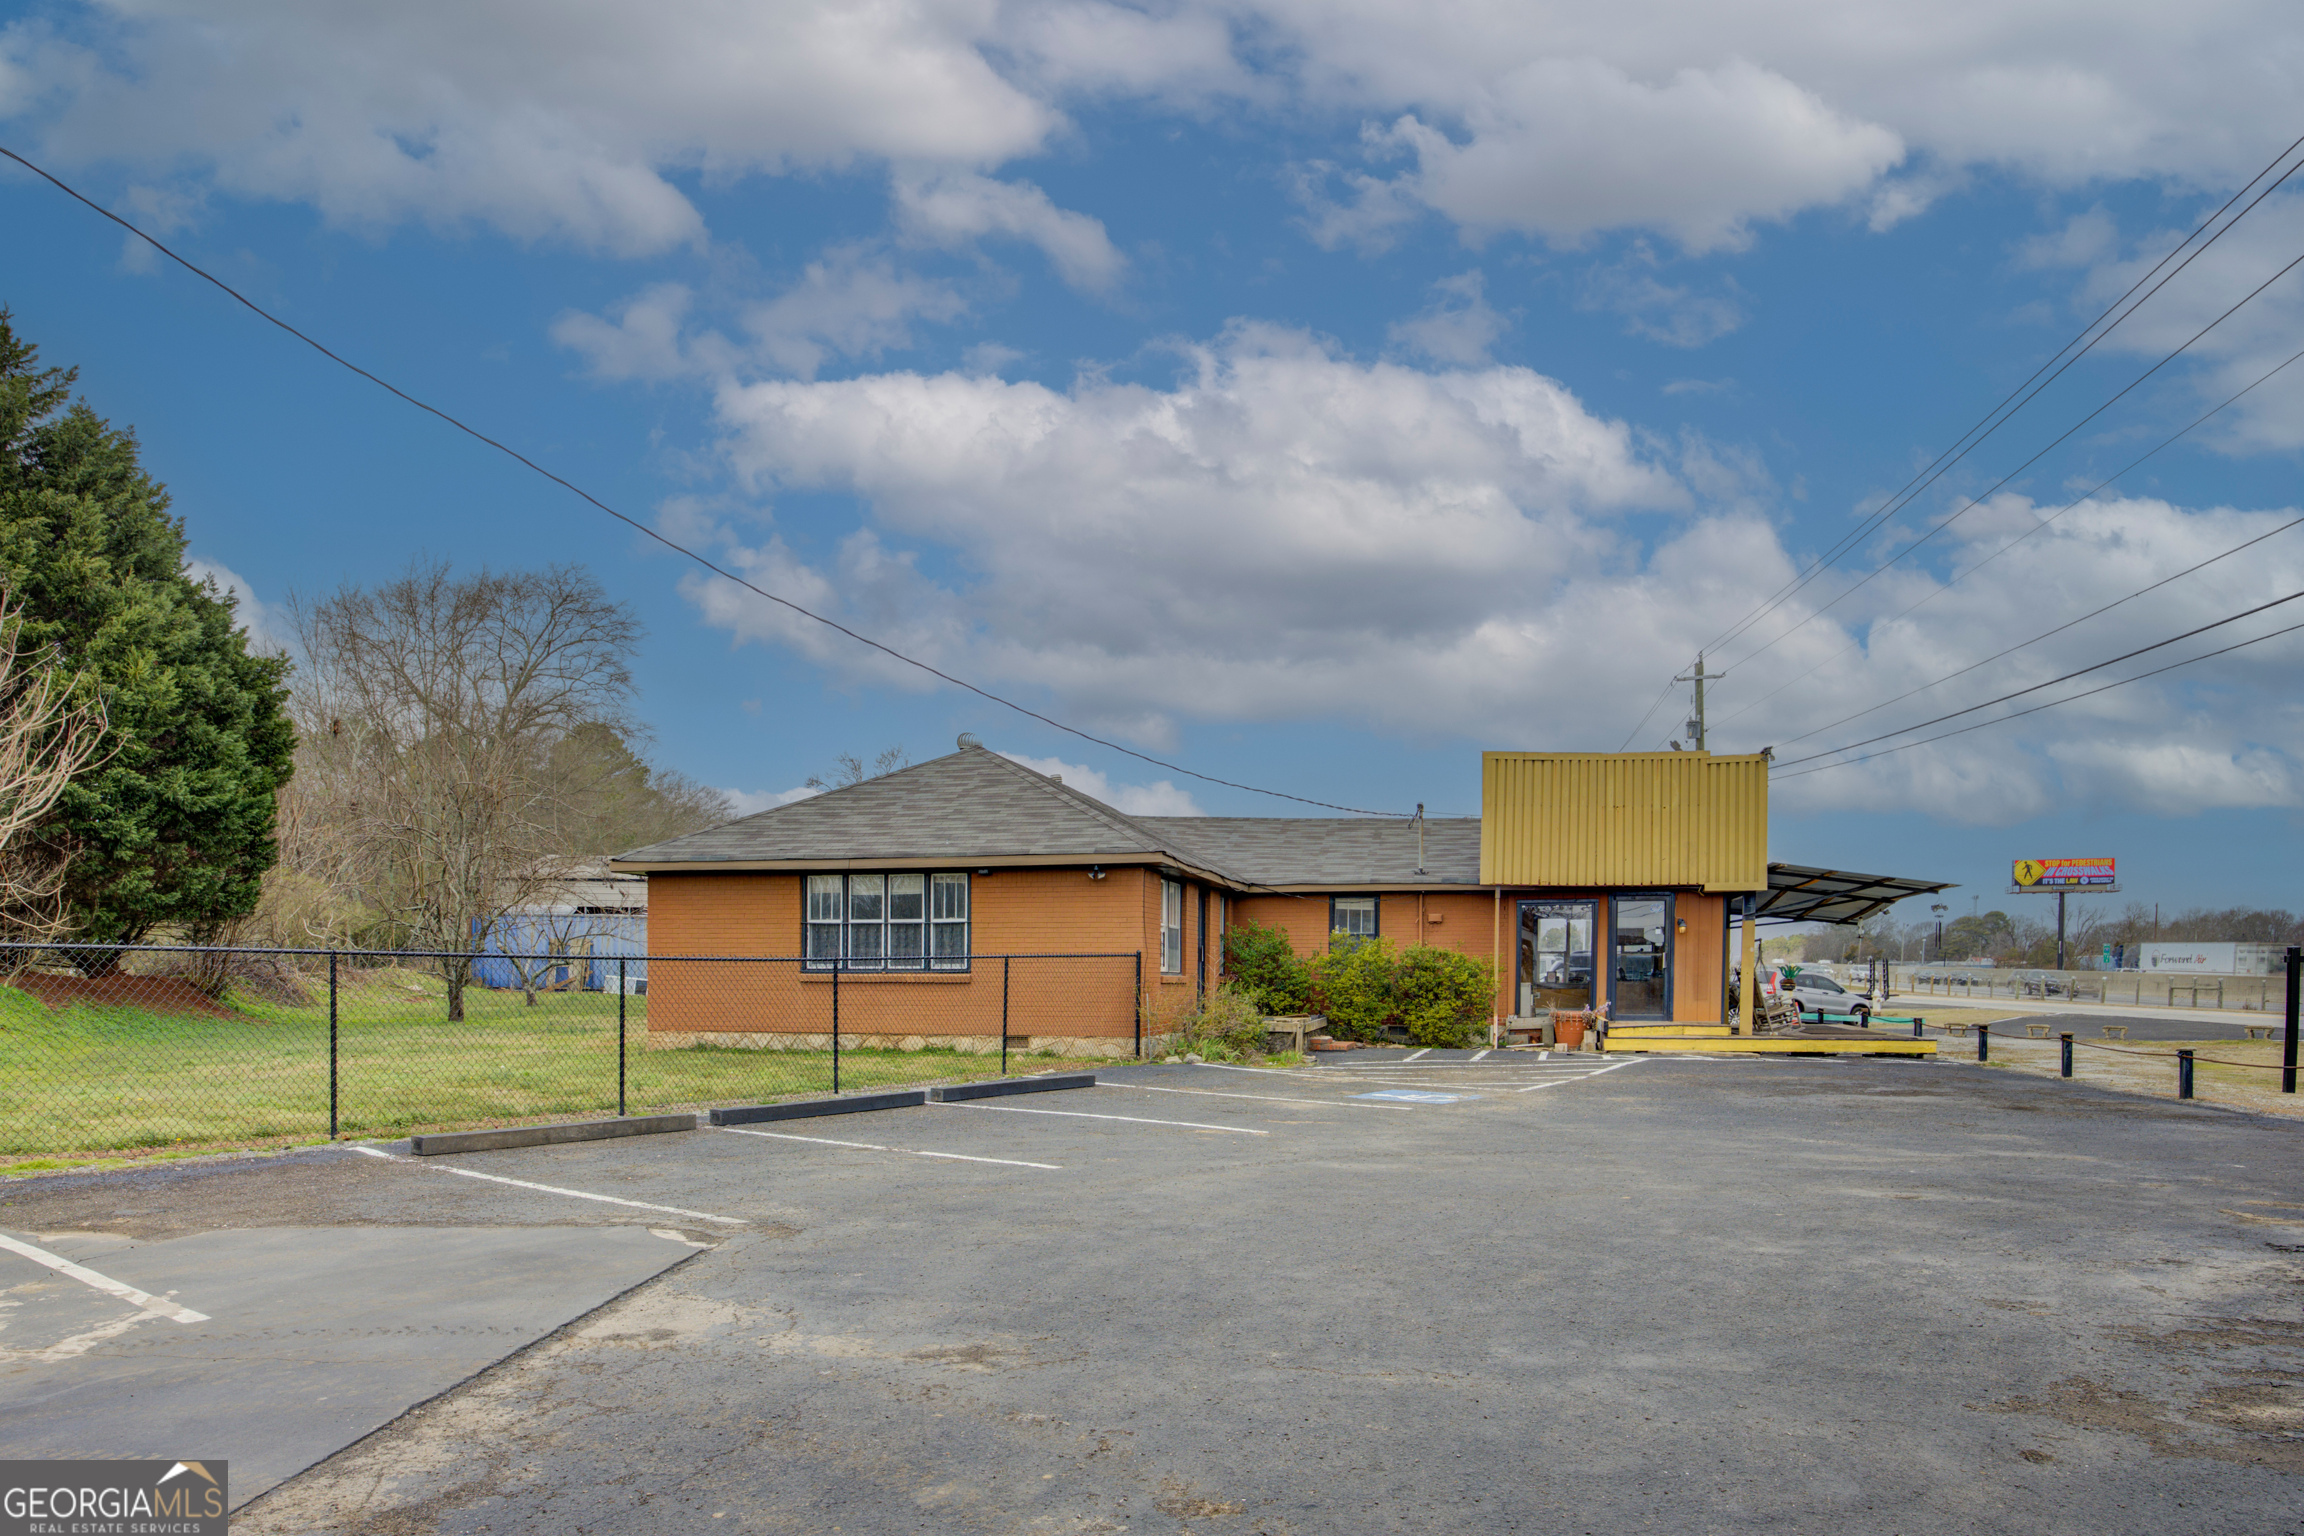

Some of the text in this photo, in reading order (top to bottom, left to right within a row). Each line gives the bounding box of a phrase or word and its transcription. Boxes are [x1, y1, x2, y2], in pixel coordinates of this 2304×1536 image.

[2071, 858, 2112, 866] PEDESTRIANS
[2043, 865, 2114, 876] IN CROSSWALKS
[2160, 953, 2207, 964] Forward Air
